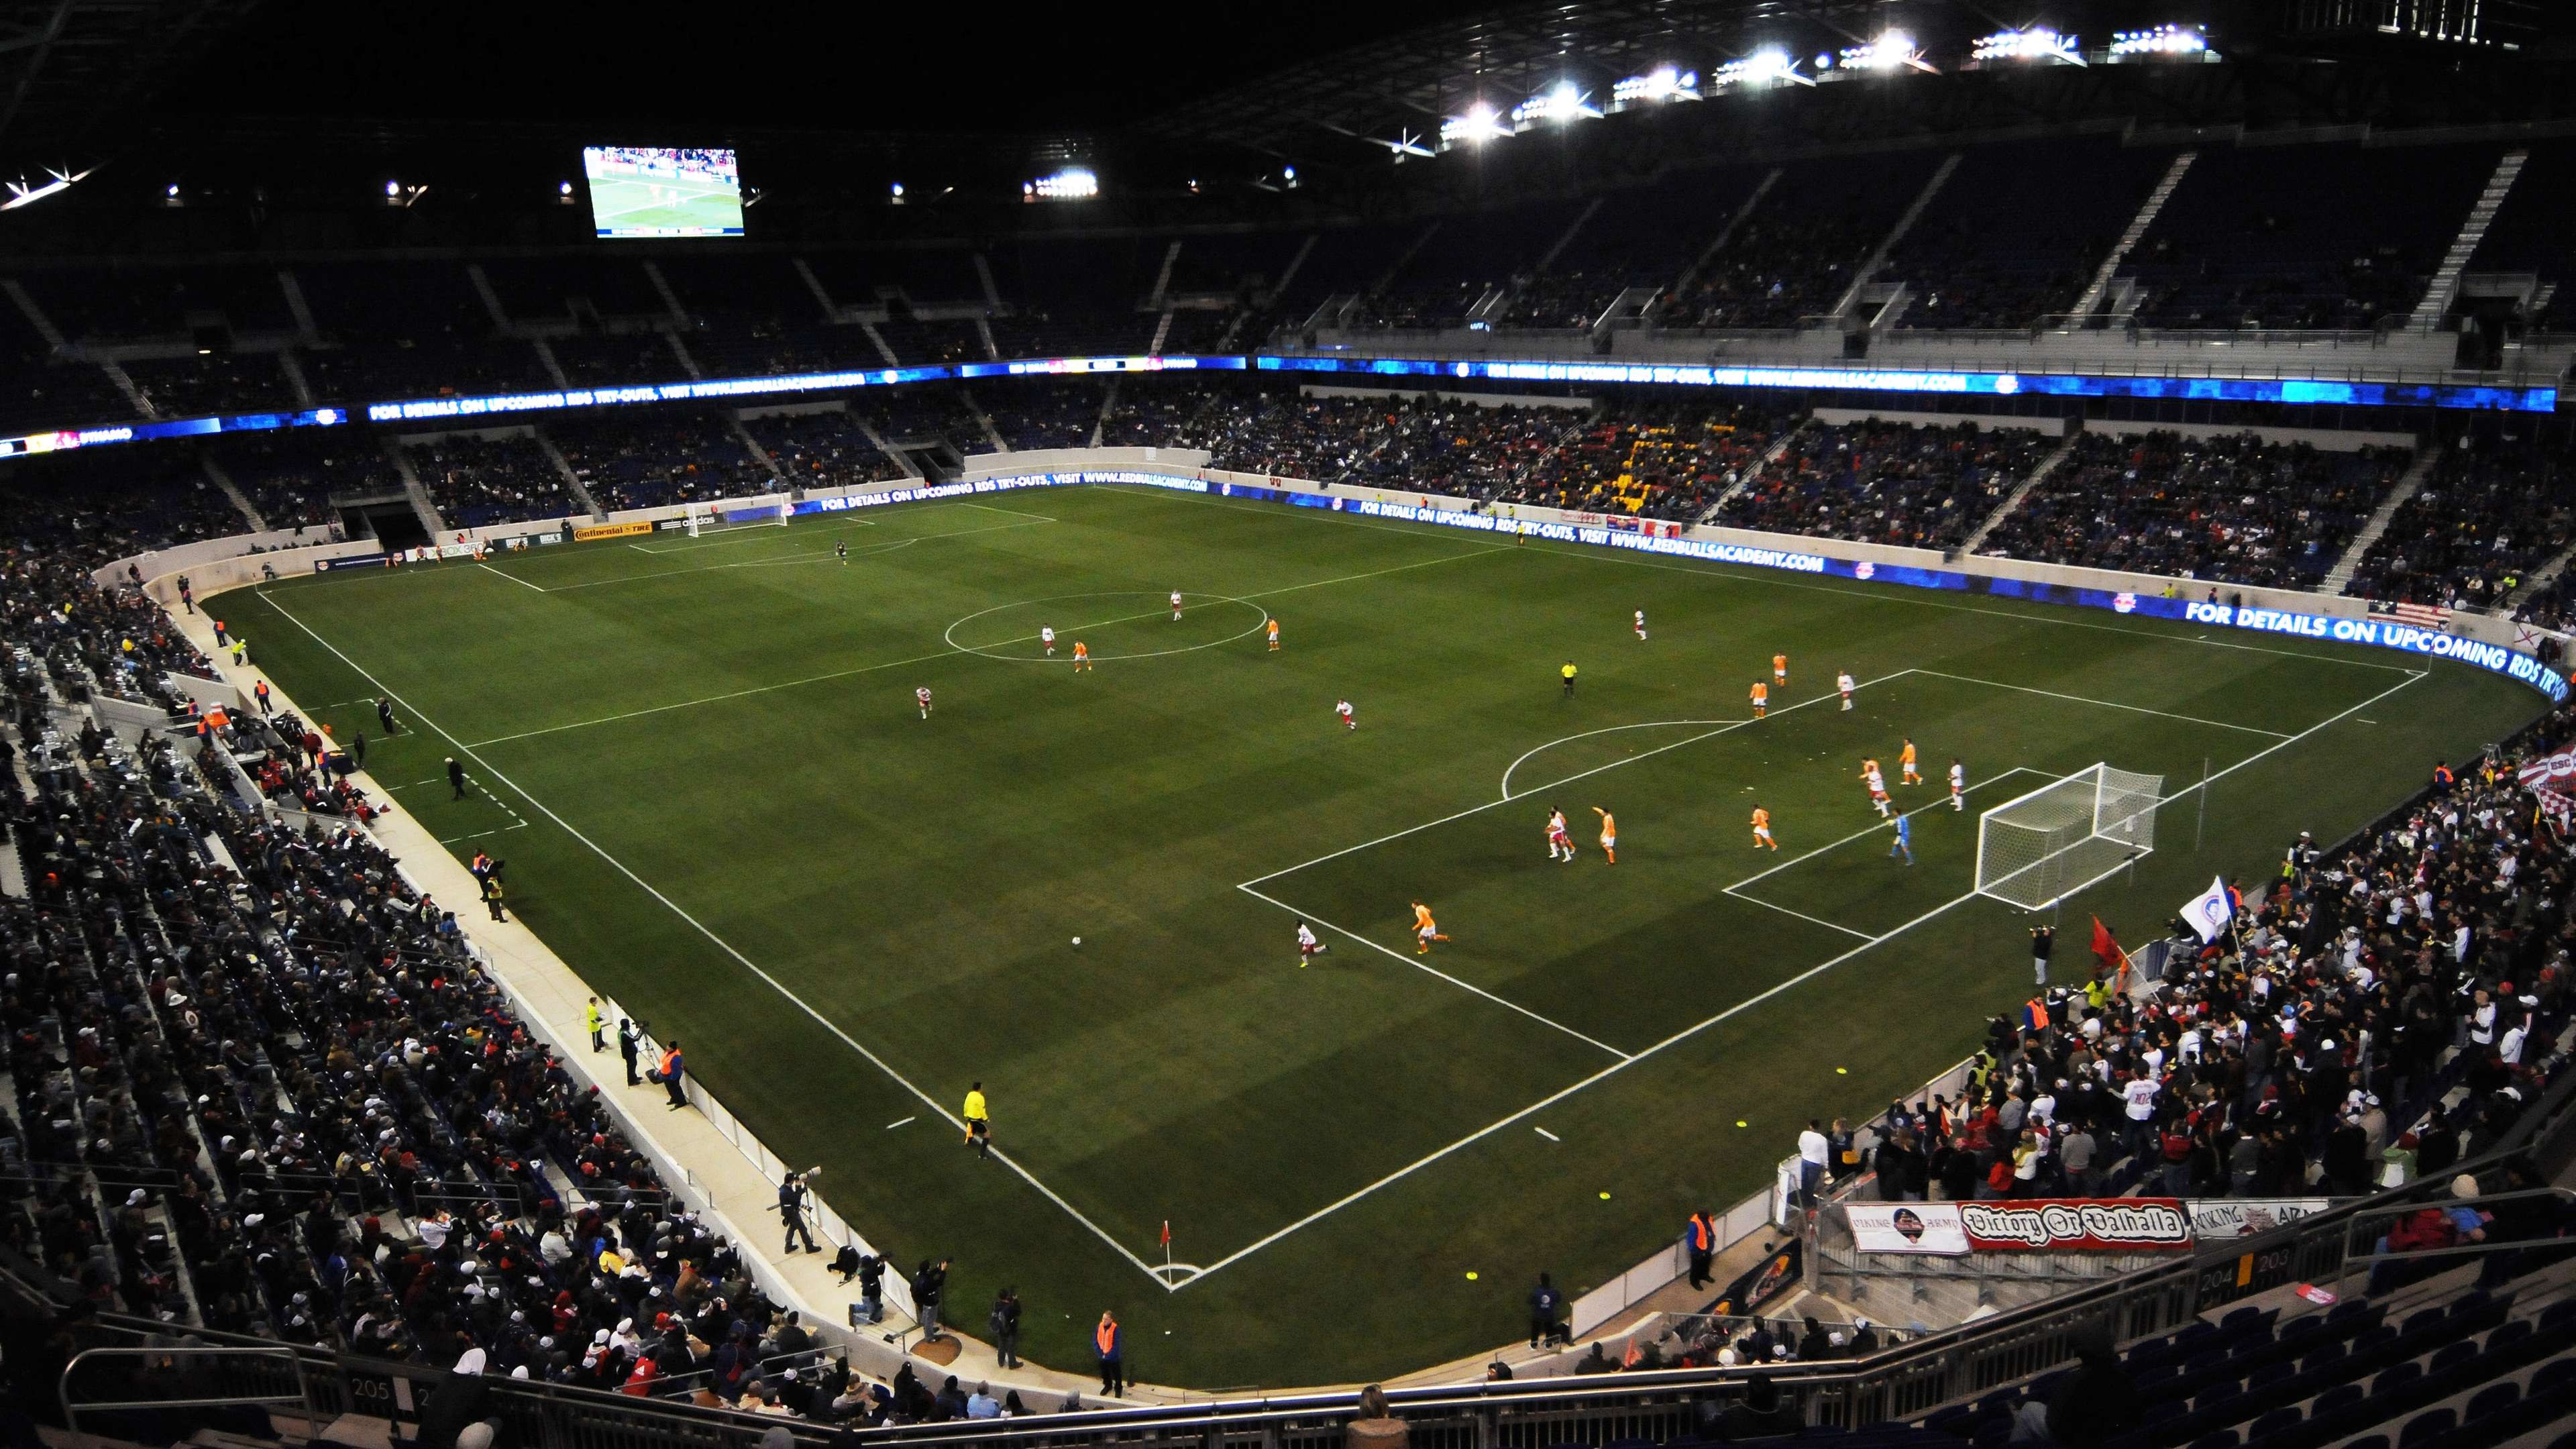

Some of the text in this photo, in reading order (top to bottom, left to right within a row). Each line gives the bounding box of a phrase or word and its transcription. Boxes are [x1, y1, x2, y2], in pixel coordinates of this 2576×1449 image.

[370, 405, 402, 420] FOR
[404, 401, 458, 417] DETAILS
[461, 399, 486, 413] ON
[488, 394, 565, 411] UPCOMING
[821, 472, 1208, 511] FOR DETAILS ON UPCOMING RDS TRY-OUTS, VISIT WWW.REDBULLSACADEMY.COM
[575, 524, 650, 540] Continental TIRE
[682, 516, 715, 527] addas
[1360, 501, 1379, 516] FOR
[1380, 503, 1416, 520] DETAILS
[1417, 508, 1435, 523] ON
[1436, 511, 1495, 531] UPCOMING
[1519, 521, 1576, 542] TRY-OUTS,
[1578, 528, 1609, 545] VISIT
[1611, 532, 1825, 573] WWW.REDBULLSACADEMY.COM
[2186, 602, 2231, 624] FOR
[2237, 609, 2327, 636] DETAILS
[2333, 620, 2378, 643] ON
[2383, 627, 2508, 669] UPCOMING
[2508, 654, 2542, 682] RDS
[1968, 1212, 2178, 1236] Victory Or Valhalla
[2192, 1205, 2243, 1231] VIKING
[2259, 1249, 2290, 1273] 203
[2200, 1269, 2233, 1292] 204
[352, 1378, 389, 1400] 205
